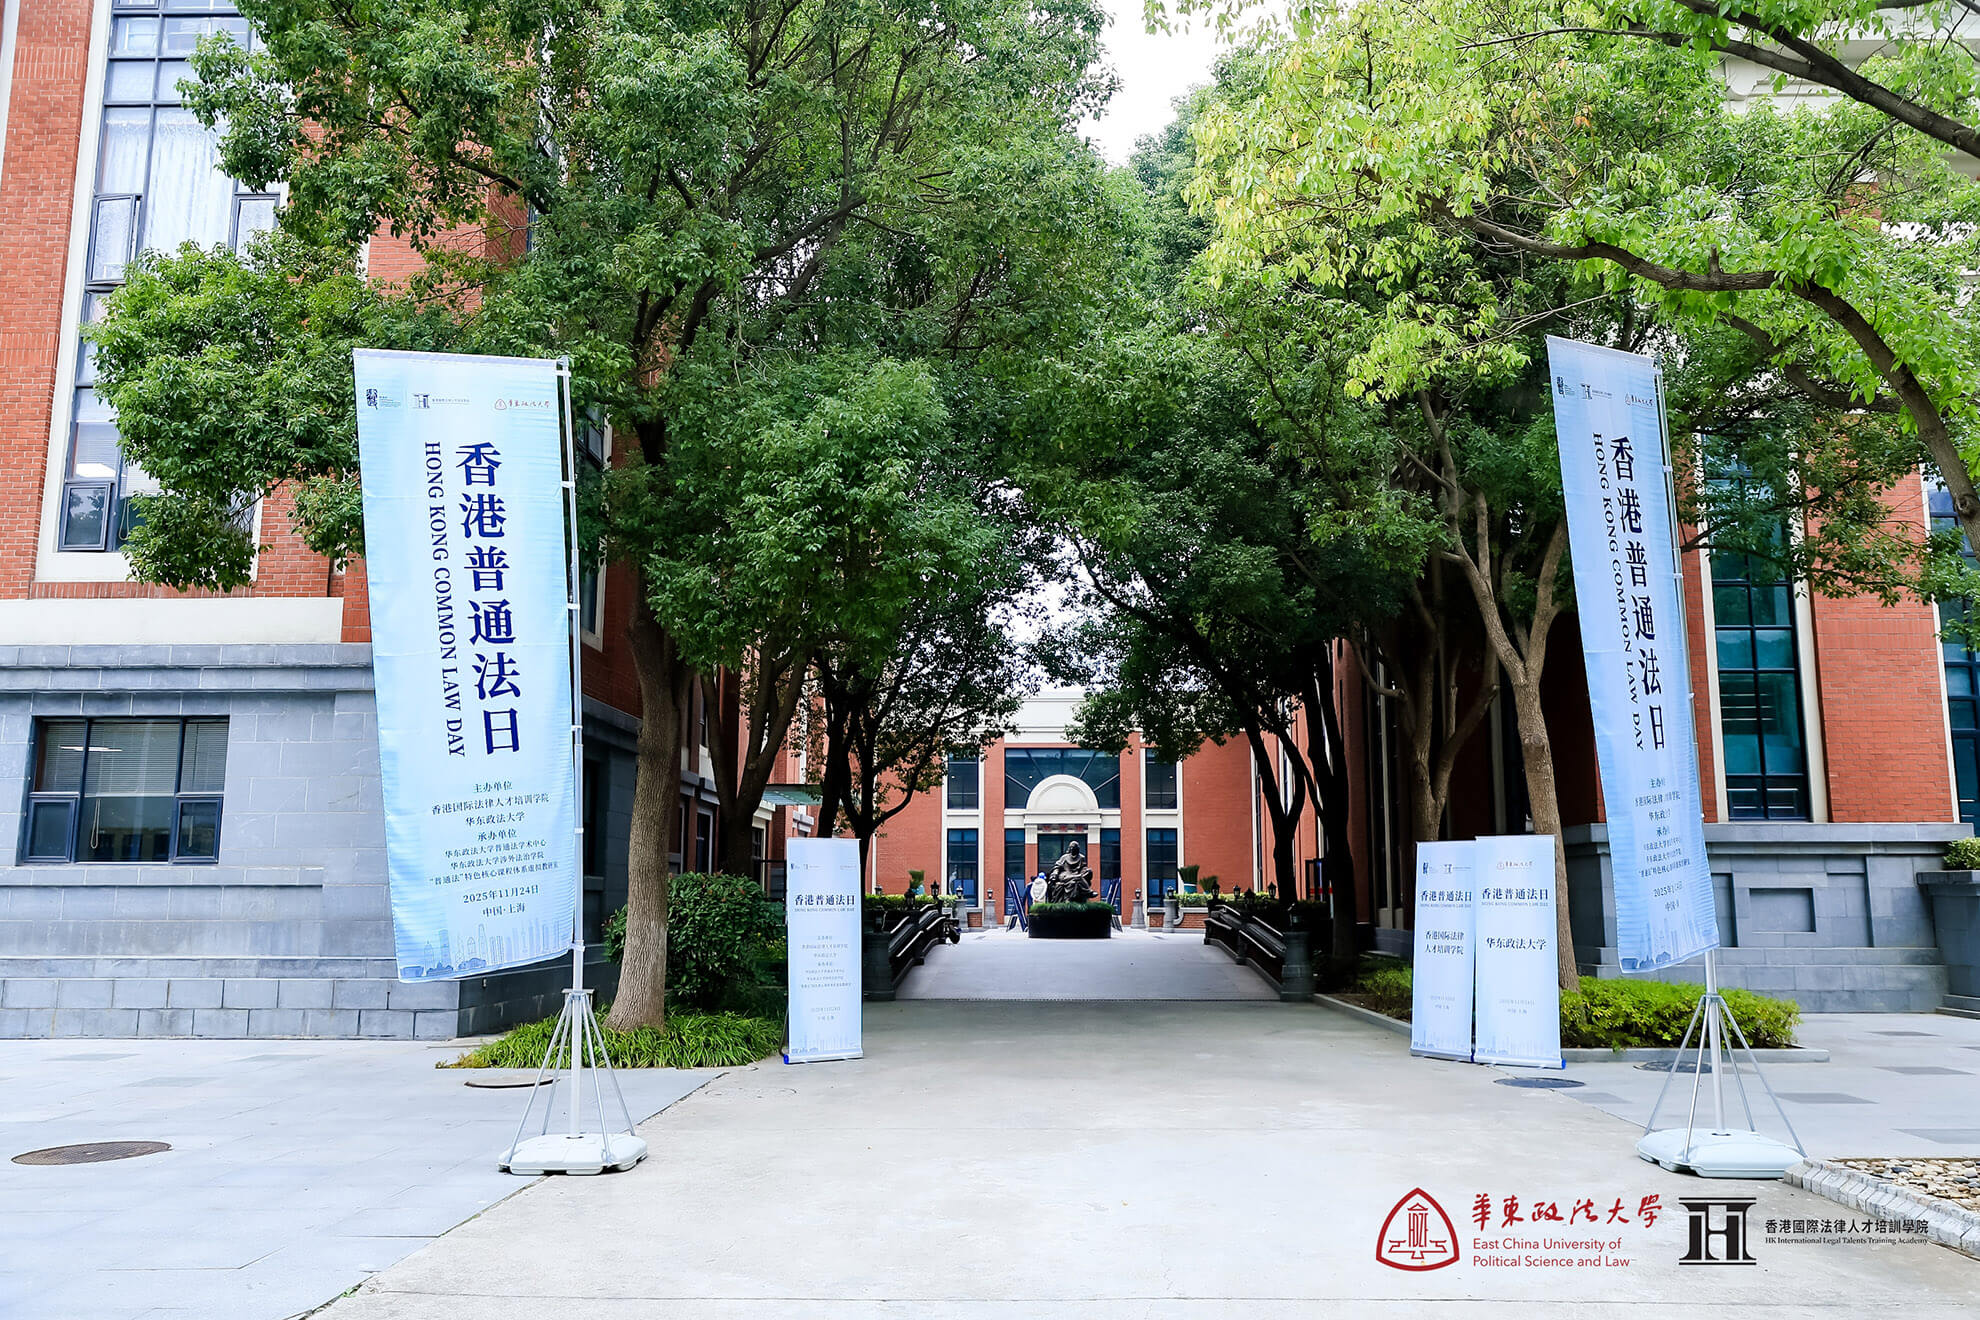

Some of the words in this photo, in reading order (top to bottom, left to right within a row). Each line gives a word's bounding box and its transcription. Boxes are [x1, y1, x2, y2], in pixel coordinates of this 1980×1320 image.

[425, 441, 444, 499] HONG
[429, 505, 449, 561] KONG
[455, 442, 521, 755] 香港普通法日
[1592, 432, 1610, 490] HONG
[1602, 497, 1619, 553] KONG
[1611, 559, 1632, 653] COMMON
[1626, 661, 1638, 704] LAW
[1632, 712, 1643, 751] DAY
[1610, 436, 1665, 750] 香港普通法日
[434, 567, 457, 660] COMMON
[442, 666, 461, 711] LAW
[446, 718, 465, 757] DAY
[474, 781, 512, 793] 主办单位
[432, 793, 549, 815] 香港国际法律人才培训学院
[465, 811, 525, 827] 华东政法大学
[478, 829, 517, 841] 承办单位
[463, 884, 539, 903] 2025年11月24日
[795, 894, 855, 905] 香港普通法日
[1421, 890, 1472, 902] 香港普通法日
[1482, 888, 1548, 900] 香港普通法日
[1486, 937, 1546, 950] 华东政法大学
